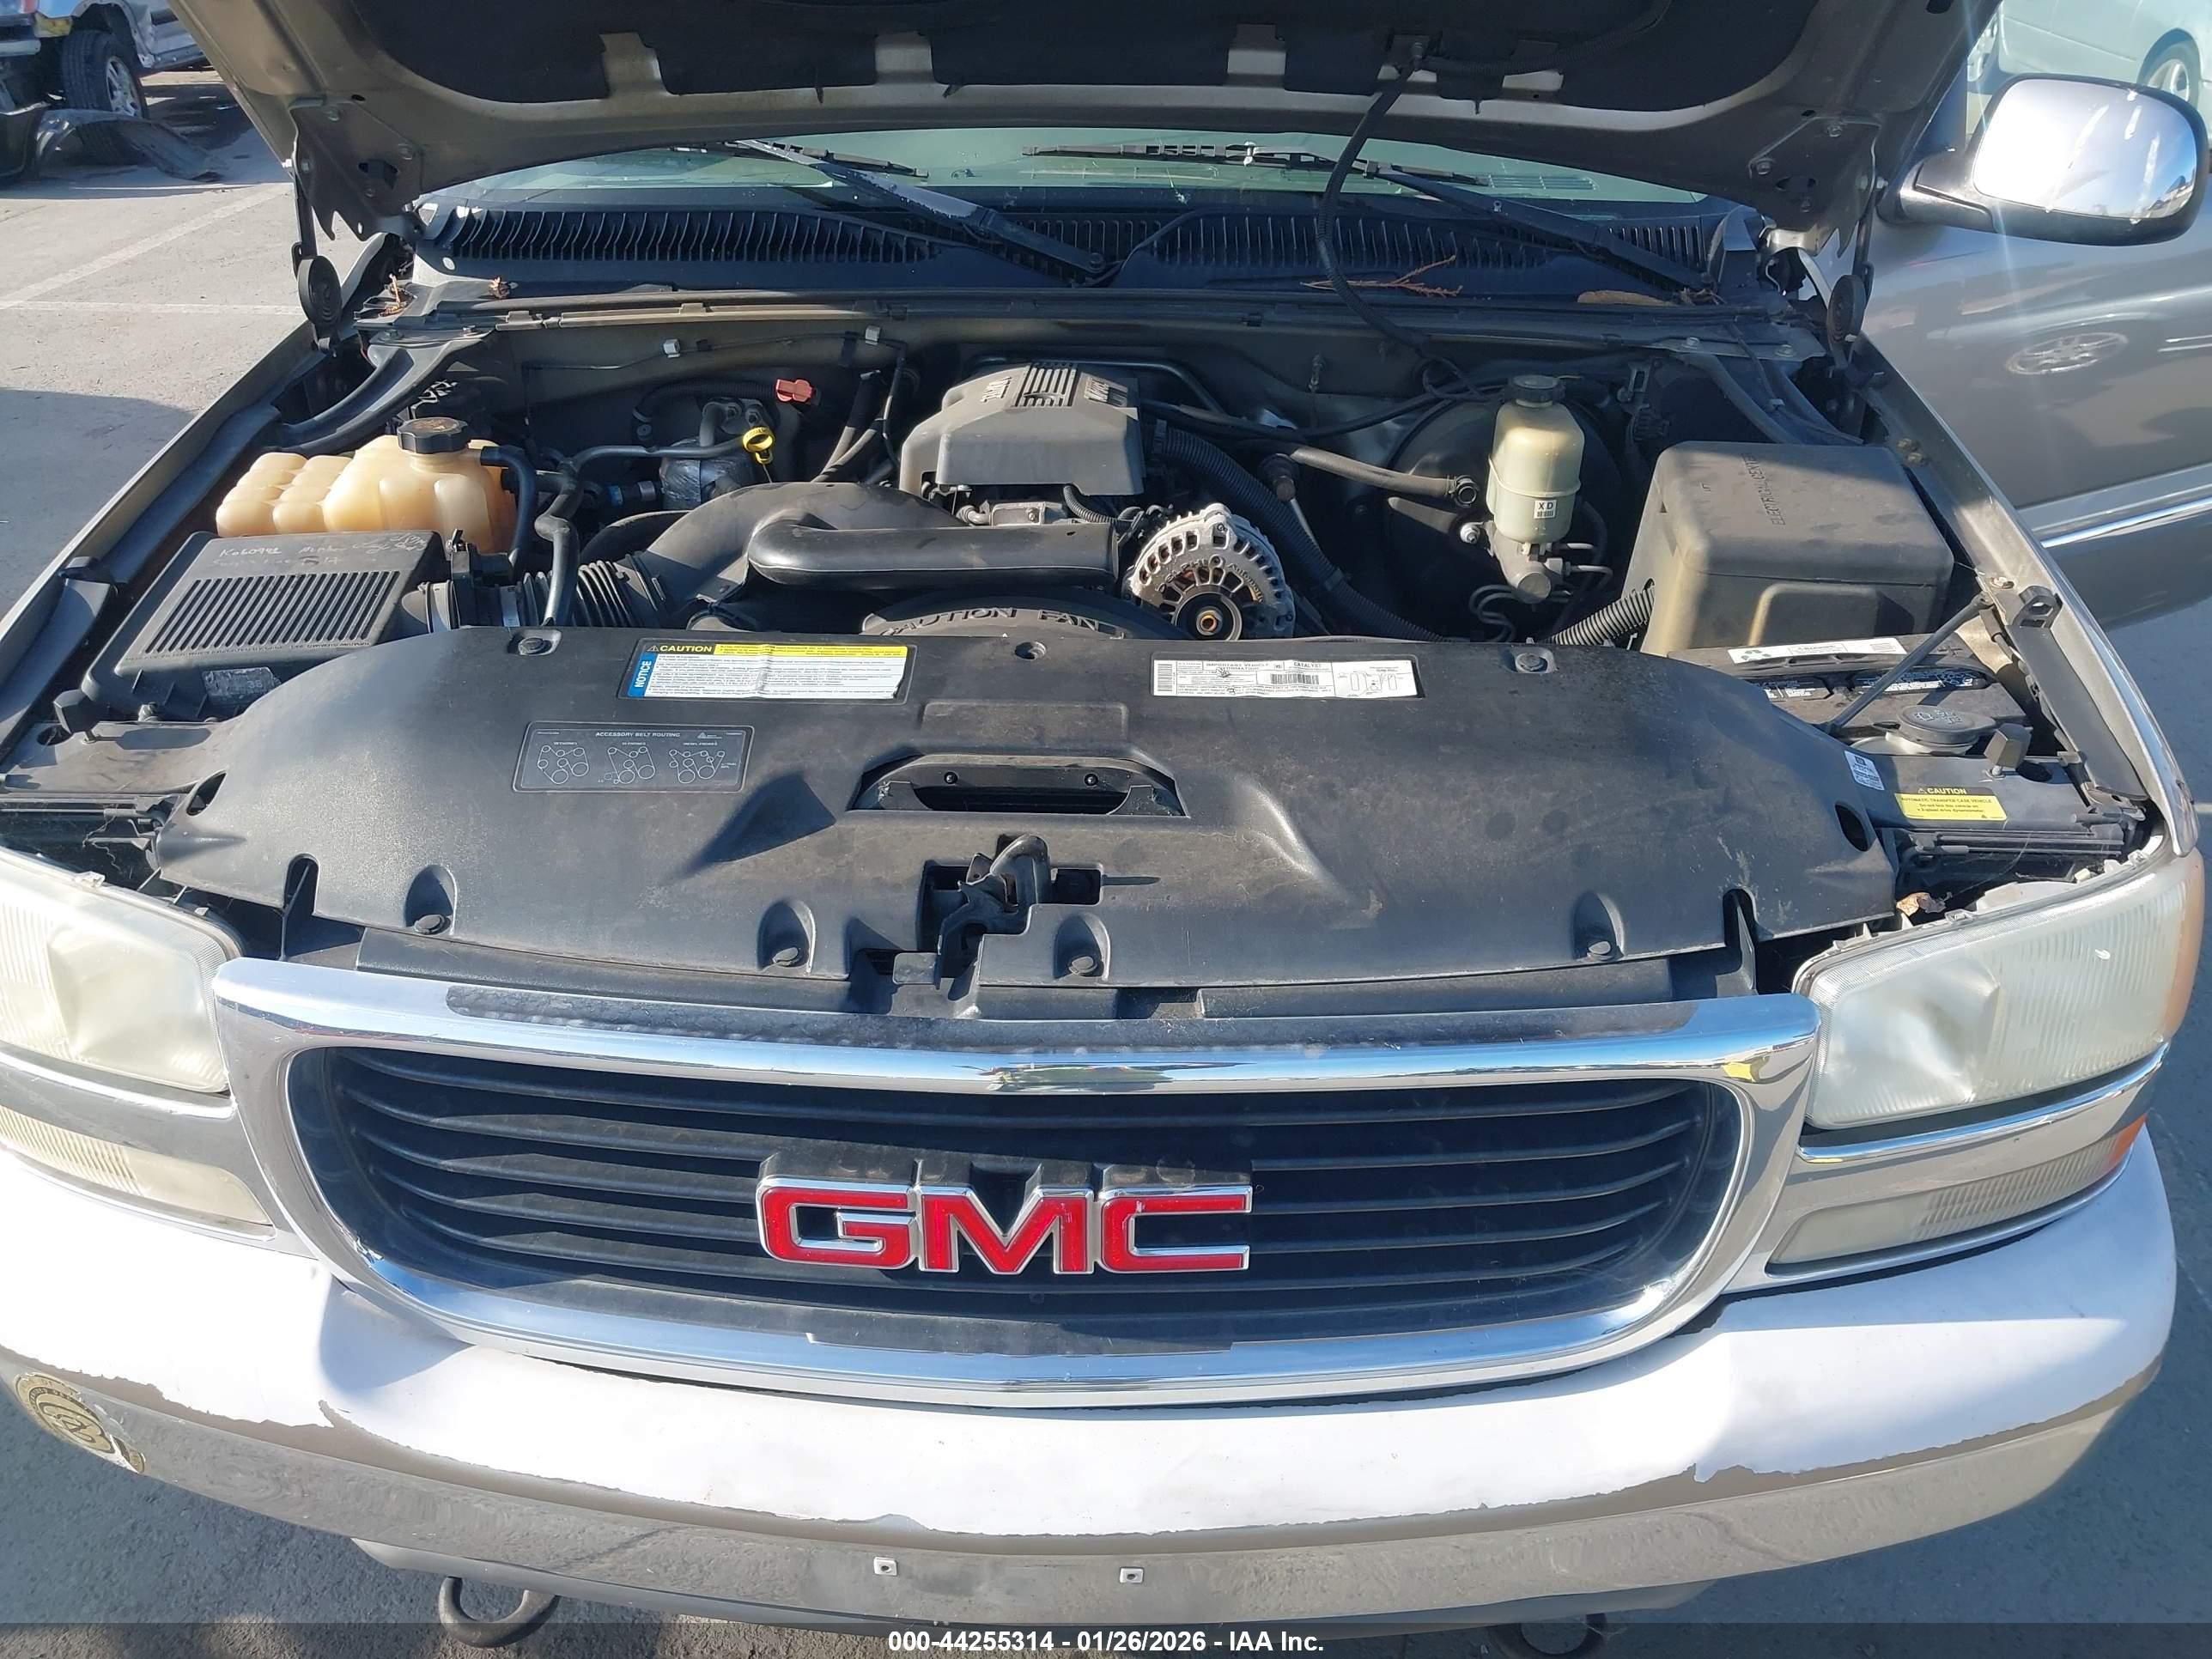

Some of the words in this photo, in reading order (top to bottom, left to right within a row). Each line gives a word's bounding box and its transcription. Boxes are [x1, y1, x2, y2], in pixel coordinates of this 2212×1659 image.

[1037, 609, 1100, 633] FAN
[635, 660, 652, 688] NOTICE
[756, 1174, 1253, 1275] GMC
